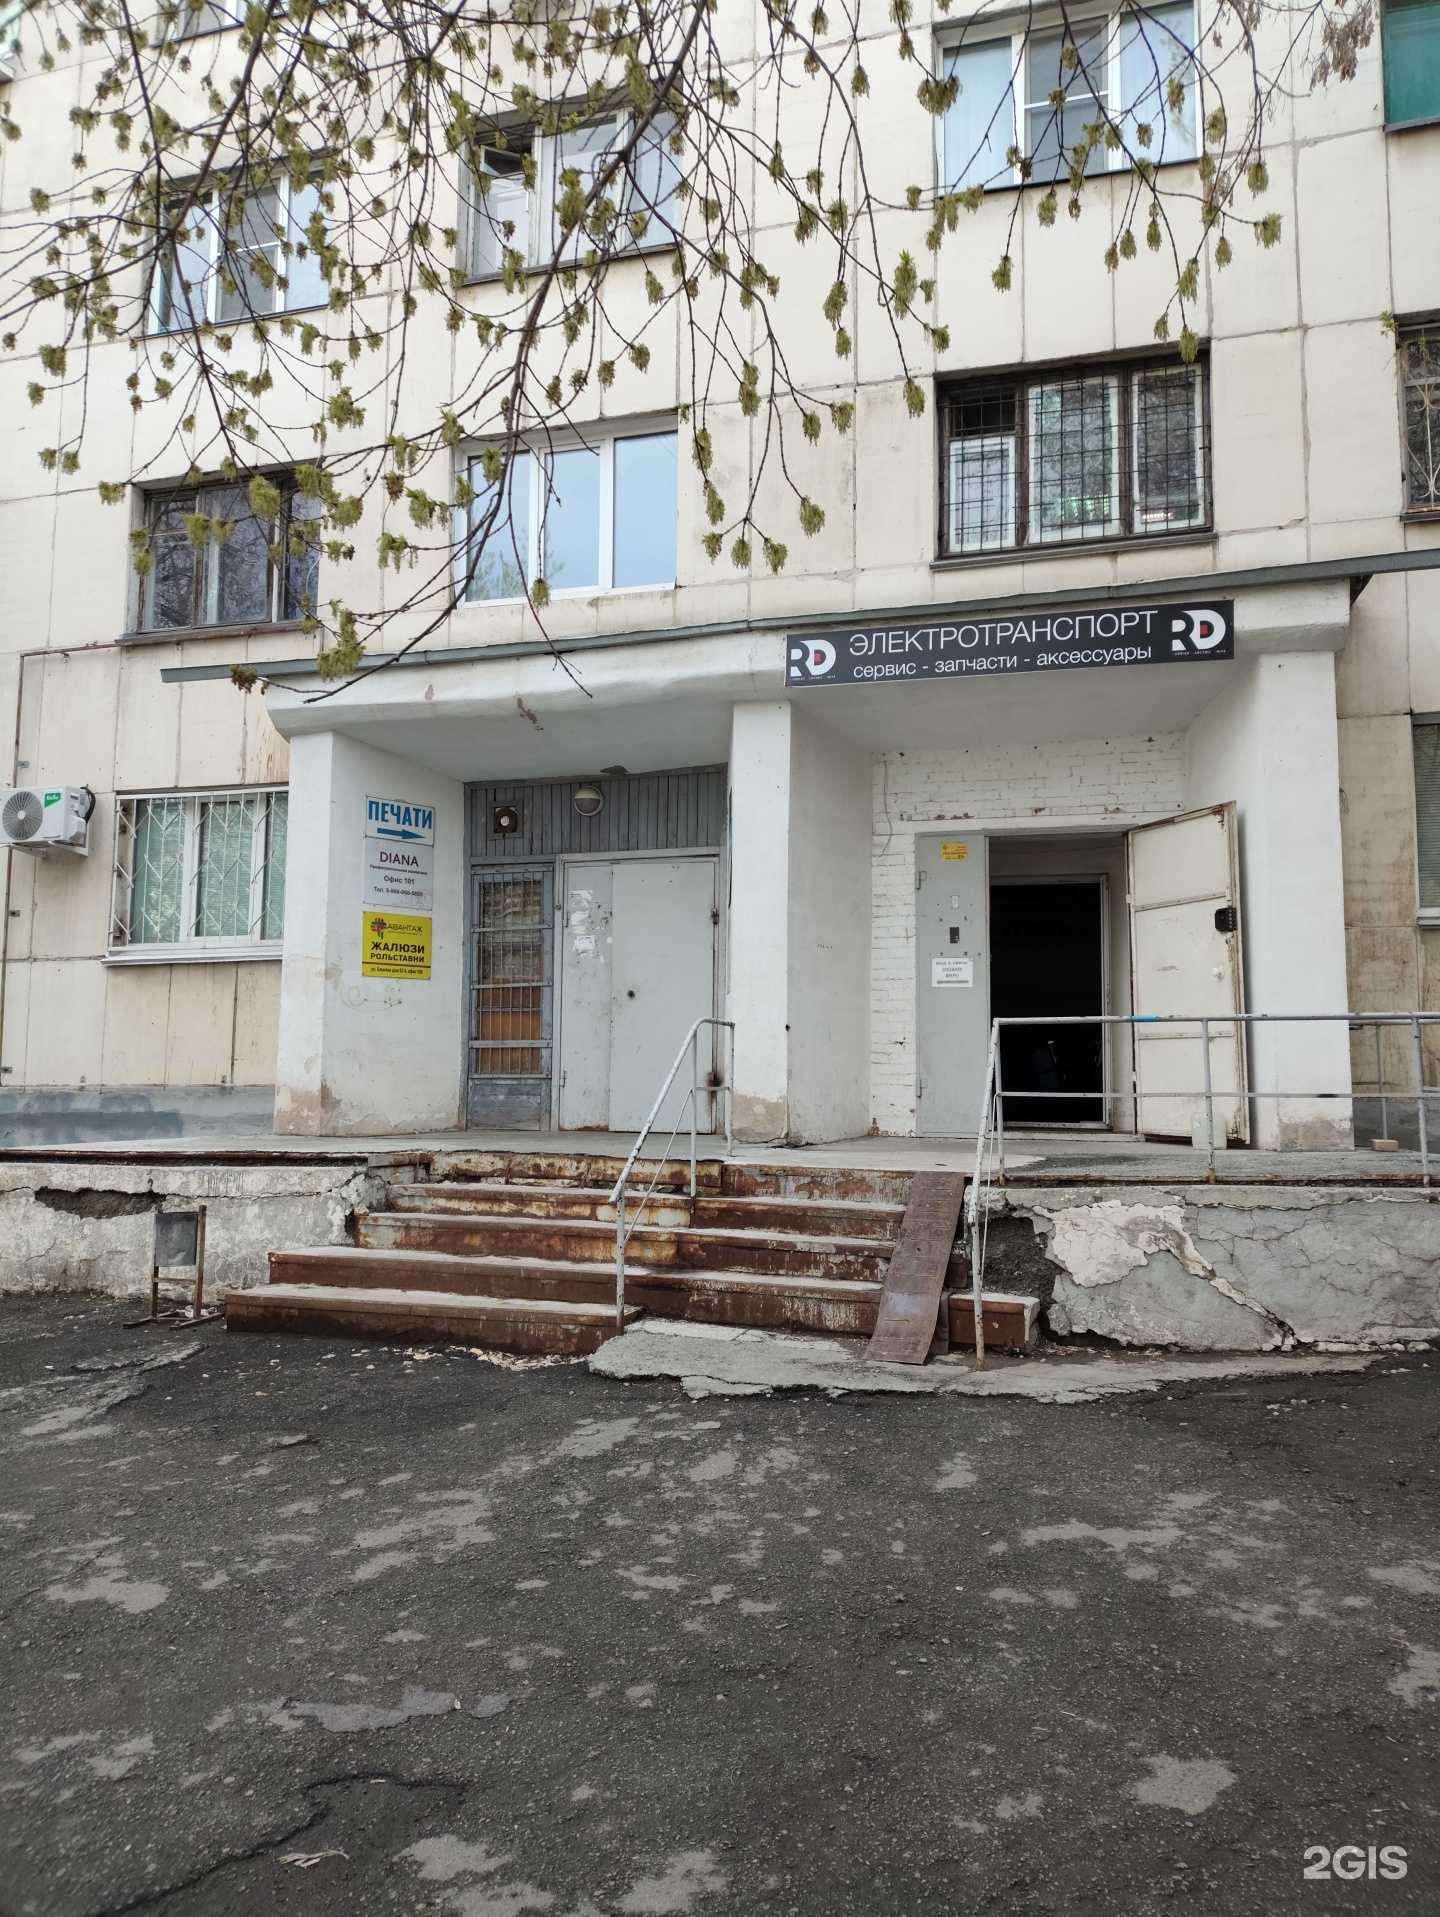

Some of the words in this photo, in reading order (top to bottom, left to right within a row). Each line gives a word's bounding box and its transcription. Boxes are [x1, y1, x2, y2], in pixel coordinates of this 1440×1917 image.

[849, 610, 1159, 656] ЭЛЕКТРОТРАНСПОРТ
[1171, 609, 1227, 652] RD
[790, 639, 837, 677] RD
[853, 662, 917, 681] сервис
[934, 655, 1018, 673] запчасти
[1036, 646, 1152, 667] аксессуары
[368, 799, 433, 830] ПЕЧАТИ
[379, 851, 419, 867] DIANA
[383, 875, 402, 885] Офис
[370, 952, 425, 963] РОЛЬСТАВНИ
[371, 941, 425, 954] ЖАЛЮЗИ
